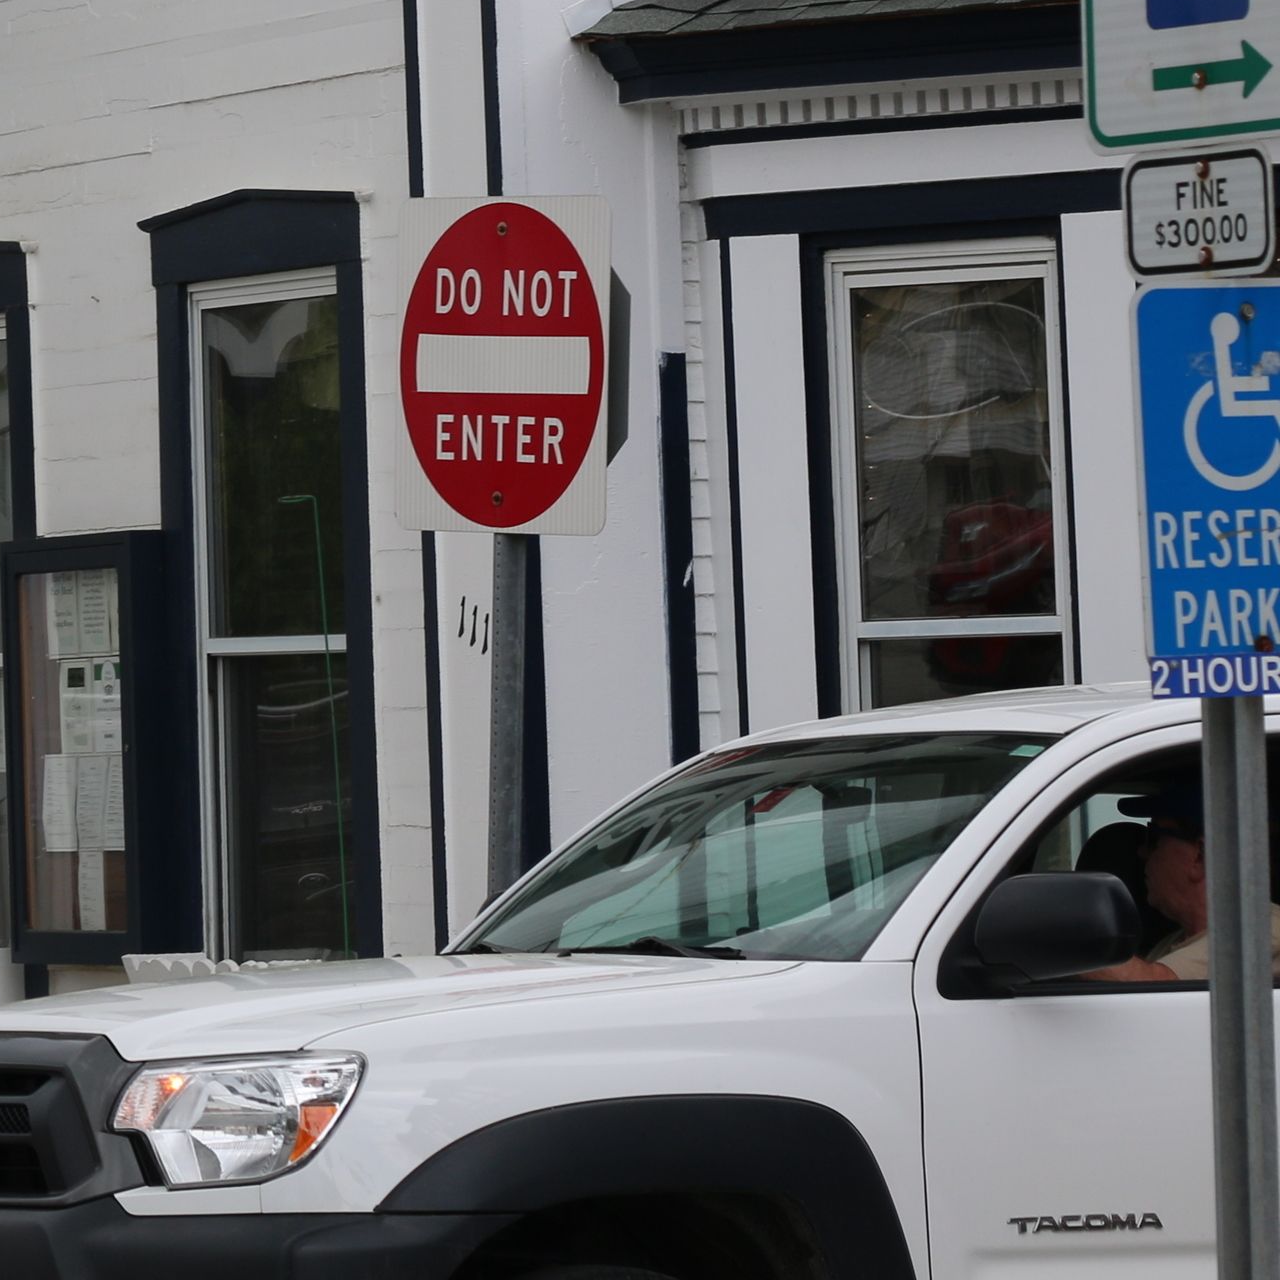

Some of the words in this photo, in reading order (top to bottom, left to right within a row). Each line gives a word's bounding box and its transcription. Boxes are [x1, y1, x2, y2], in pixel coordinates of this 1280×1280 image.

[1176, 178, 1228, 210] FINE
[1155, 213, 1247, 248] $300.00
[435, 268, 482, 316] DO
[502, 270, 578, 317] NOT
[436, 414, 564, 465] ENTER
[1153, 509, 1280, 569] RESER
[458, 595, 490, 656] 111
[1174, 588, 1280, 649] PARK
[1152, 660, 1171, 696] 2
[1181, 656, 1280, 695] HOUR
[1007, 1212, 1164, 1234] TACOMA
